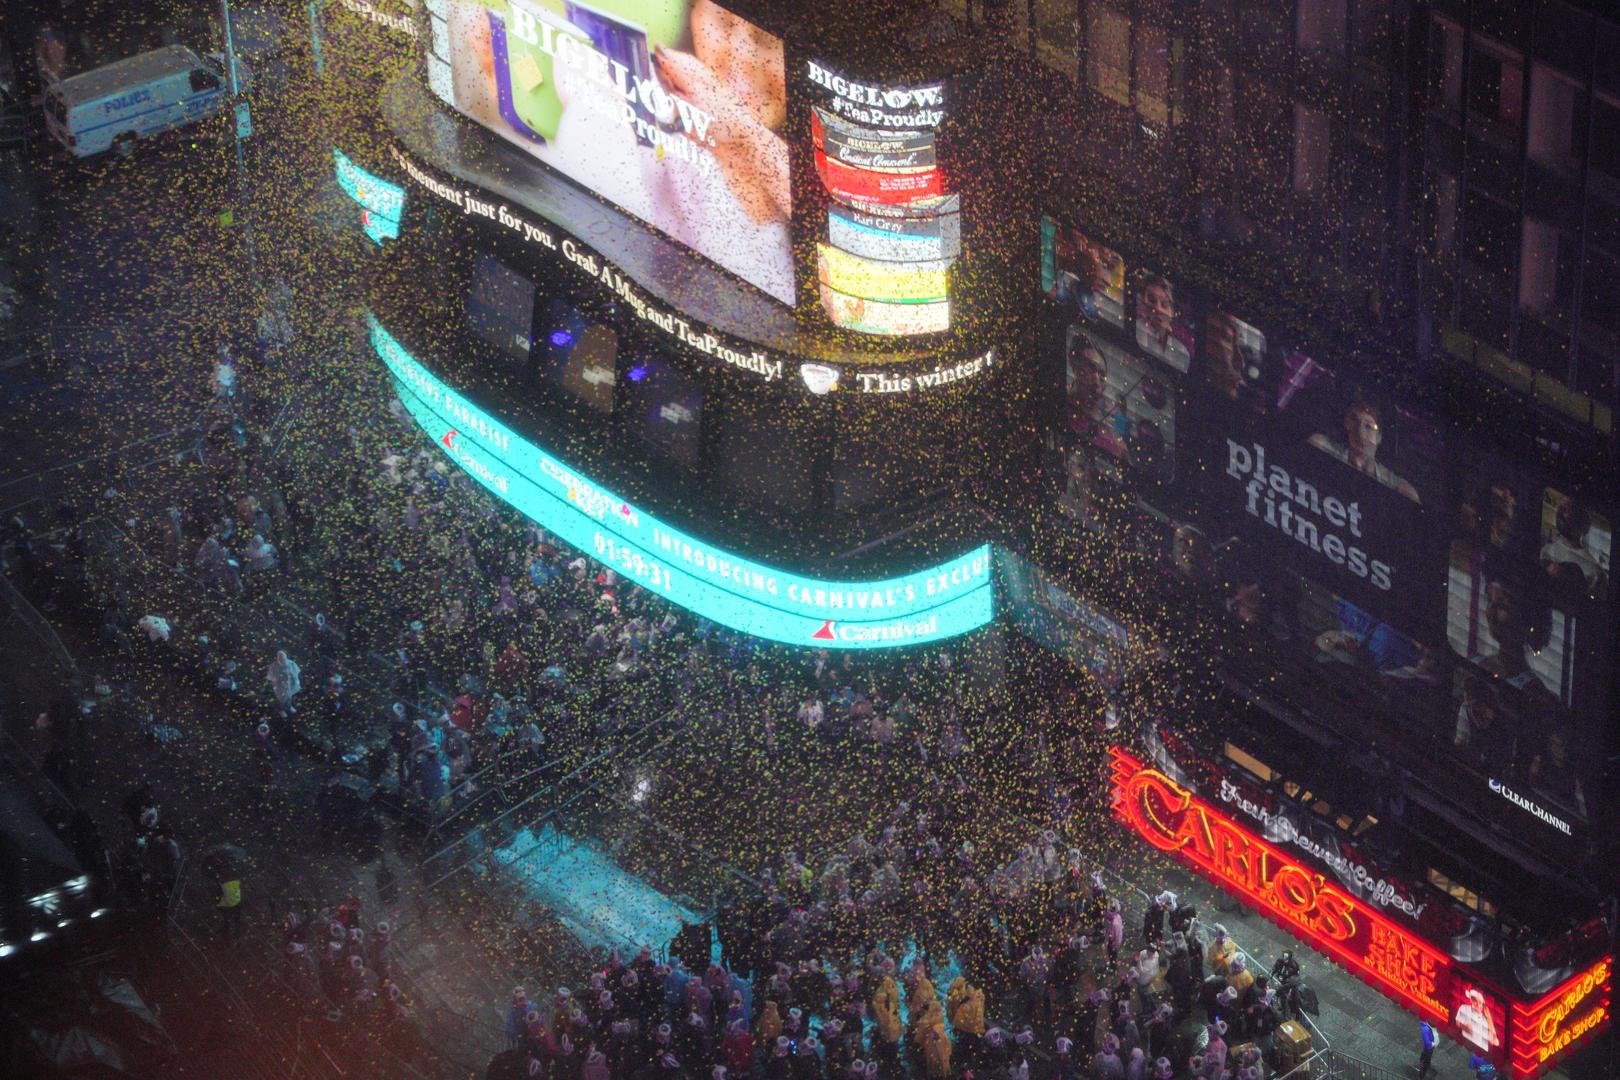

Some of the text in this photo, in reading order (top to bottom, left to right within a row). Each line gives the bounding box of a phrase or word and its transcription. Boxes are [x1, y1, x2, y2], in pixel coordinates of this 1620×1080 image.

[103, 88, 151, 114] POLICE
[507, 3, 714, 142] BIGELOW
[807, 60, 943, 108] BIGELOW
[832, 96, 944, 127] #TeaProudly
[463, 190, 496, 220] just
[499, 206, 522, 232] for
[523, 223, 557, 250] you.
[562, 240, 599, 276] Grab
[601, 266, 614, 289] A
[615, 274, 646, 319] Mug
[647, 307, 674, 334] and
[674, 319, 783, 382] TeaProudly!
[856, 373, 912, 393] This
[915, 357, 983, 388] winter
[445, 394, 510, 454] PARADISE
[1226, 437, 1362, 538] planet
[594, 532, 671, 587] 01:59:31
[1246, 478, 1392, 591] fitness
[653, 528, 778, 596] INTRODUCING
[787, 583, 915, 609] CARNIVAL'S
[839, 616, 937, 641] Carnival
[1127, 768, 1358, 941] CARLO'S
[1220, 779, 1428, 920] Fresh Brewed Coffee!
[1369, 943, 1436, 997] SHOP
[1370, 921, 1437, 979] BAKE
[1539, 962, 1607, 1044] CARLO'S
[1539, 1007, 1605, 1063] BAKE SHOP
